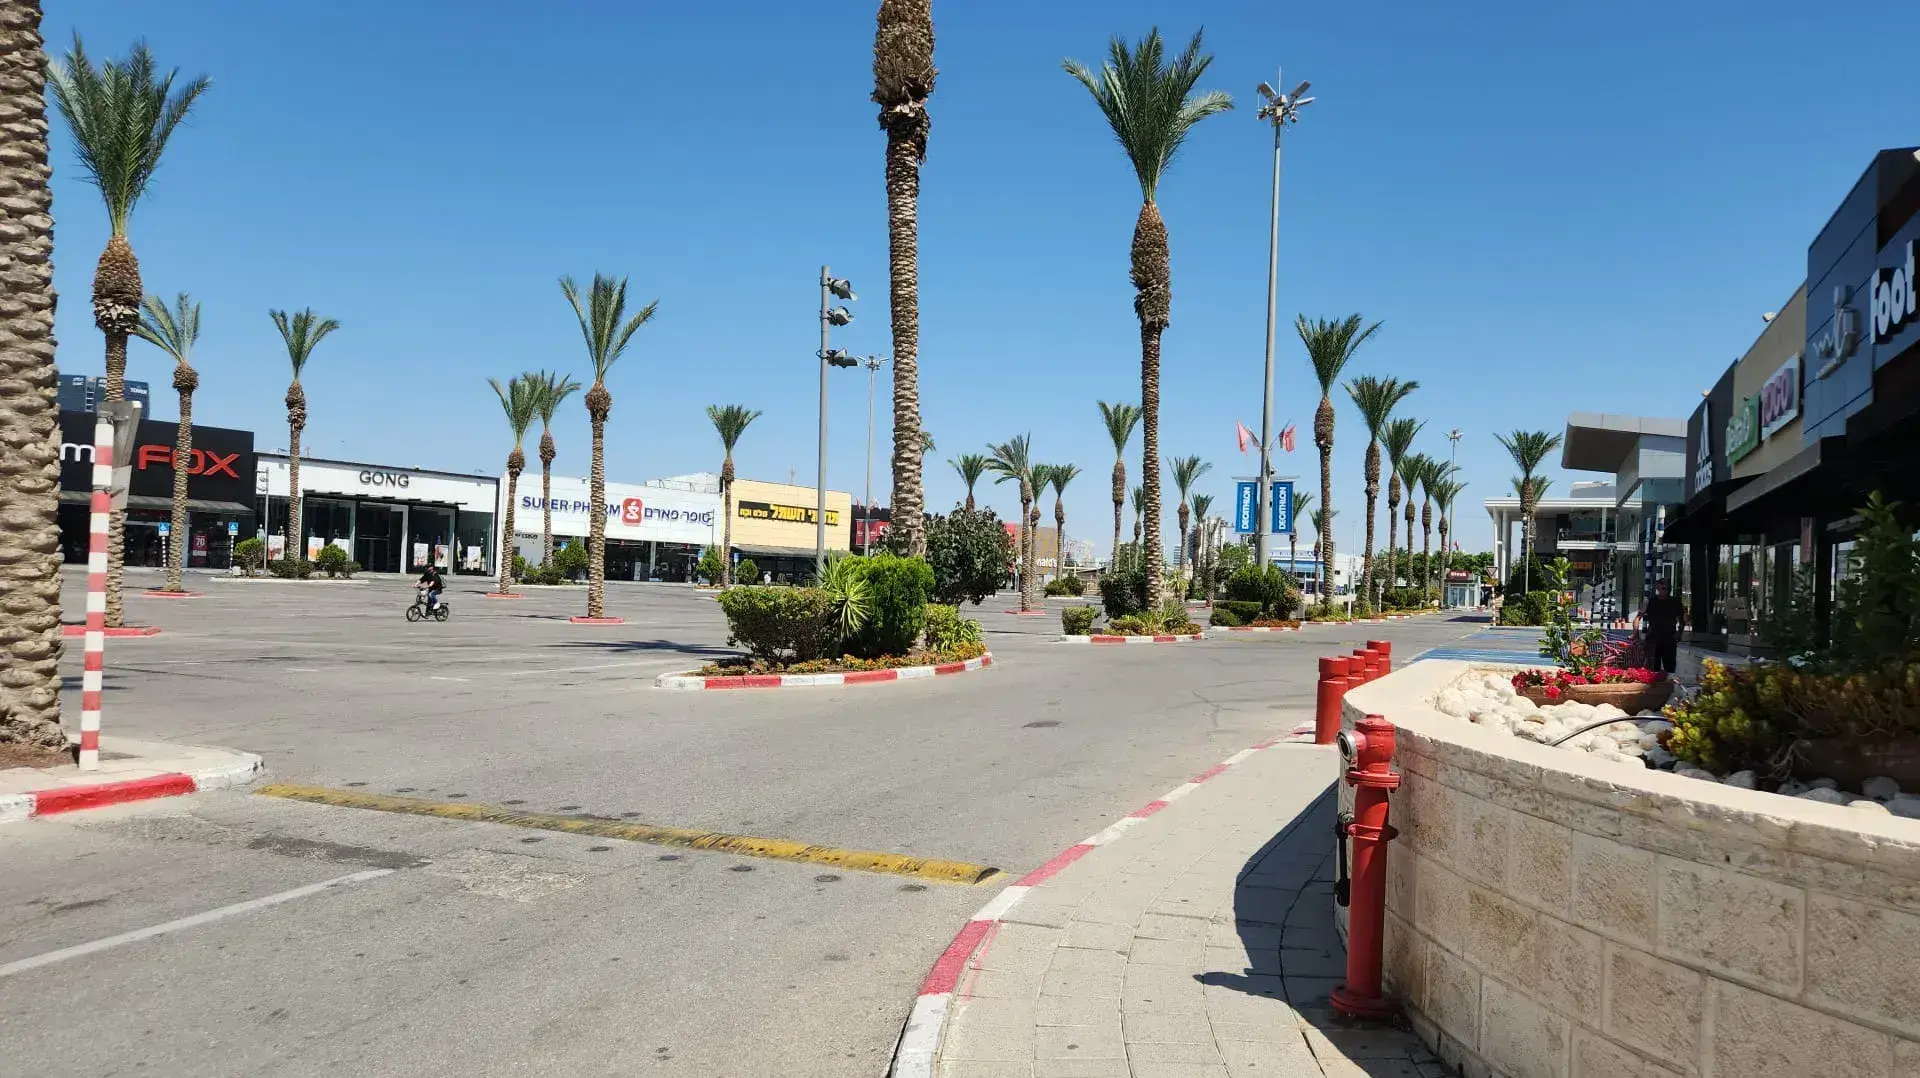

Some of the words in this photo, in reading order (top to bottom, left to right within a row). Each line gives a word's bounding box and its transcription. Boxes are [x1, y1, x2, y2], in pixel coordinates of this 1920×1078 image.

[137, 444, 241, 480] FOX
[359, 470, 409, 488] GONG
[1241, 486, 1251, 530] DECATHLON
[1278, 486, 1287, 530] DECATHLON
